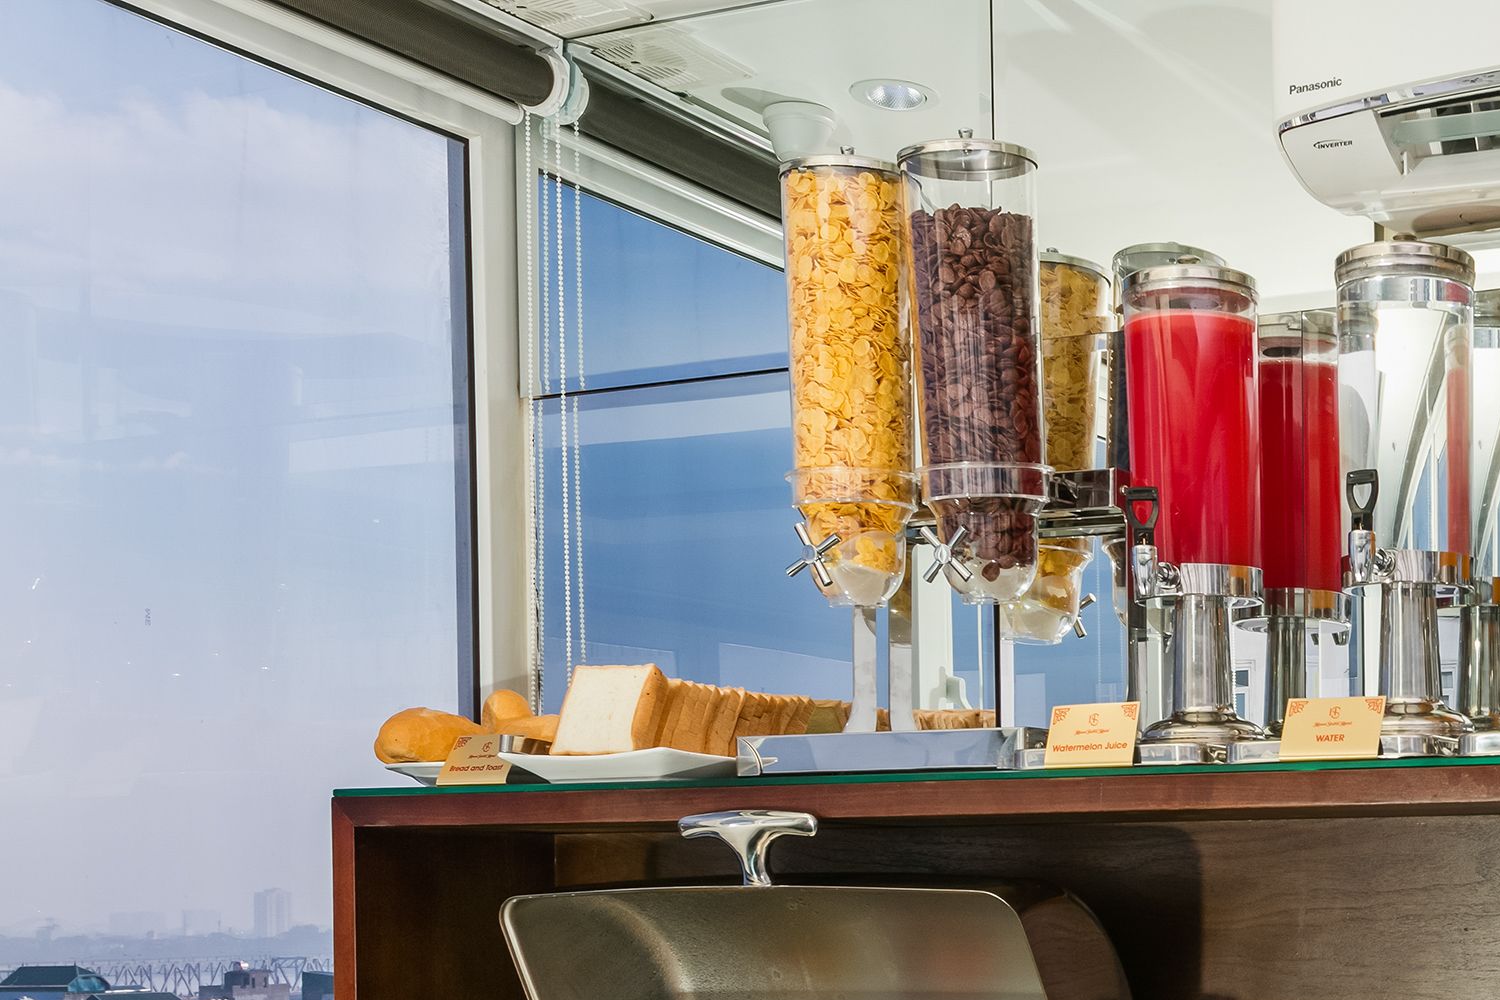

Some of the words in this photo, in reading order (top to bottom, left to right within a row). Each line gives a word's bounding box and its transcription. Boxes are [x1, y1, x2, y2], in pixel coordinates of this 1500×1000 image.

[1289, 77, 1342, 95] Panasonic
[1317, 140, 1353, 149] INVERTER
[1316, 734, 1345, 743] WATER
[1052, 743, 1103, 752] Watermelon
[1105, 741, 1128, 750] Juice
